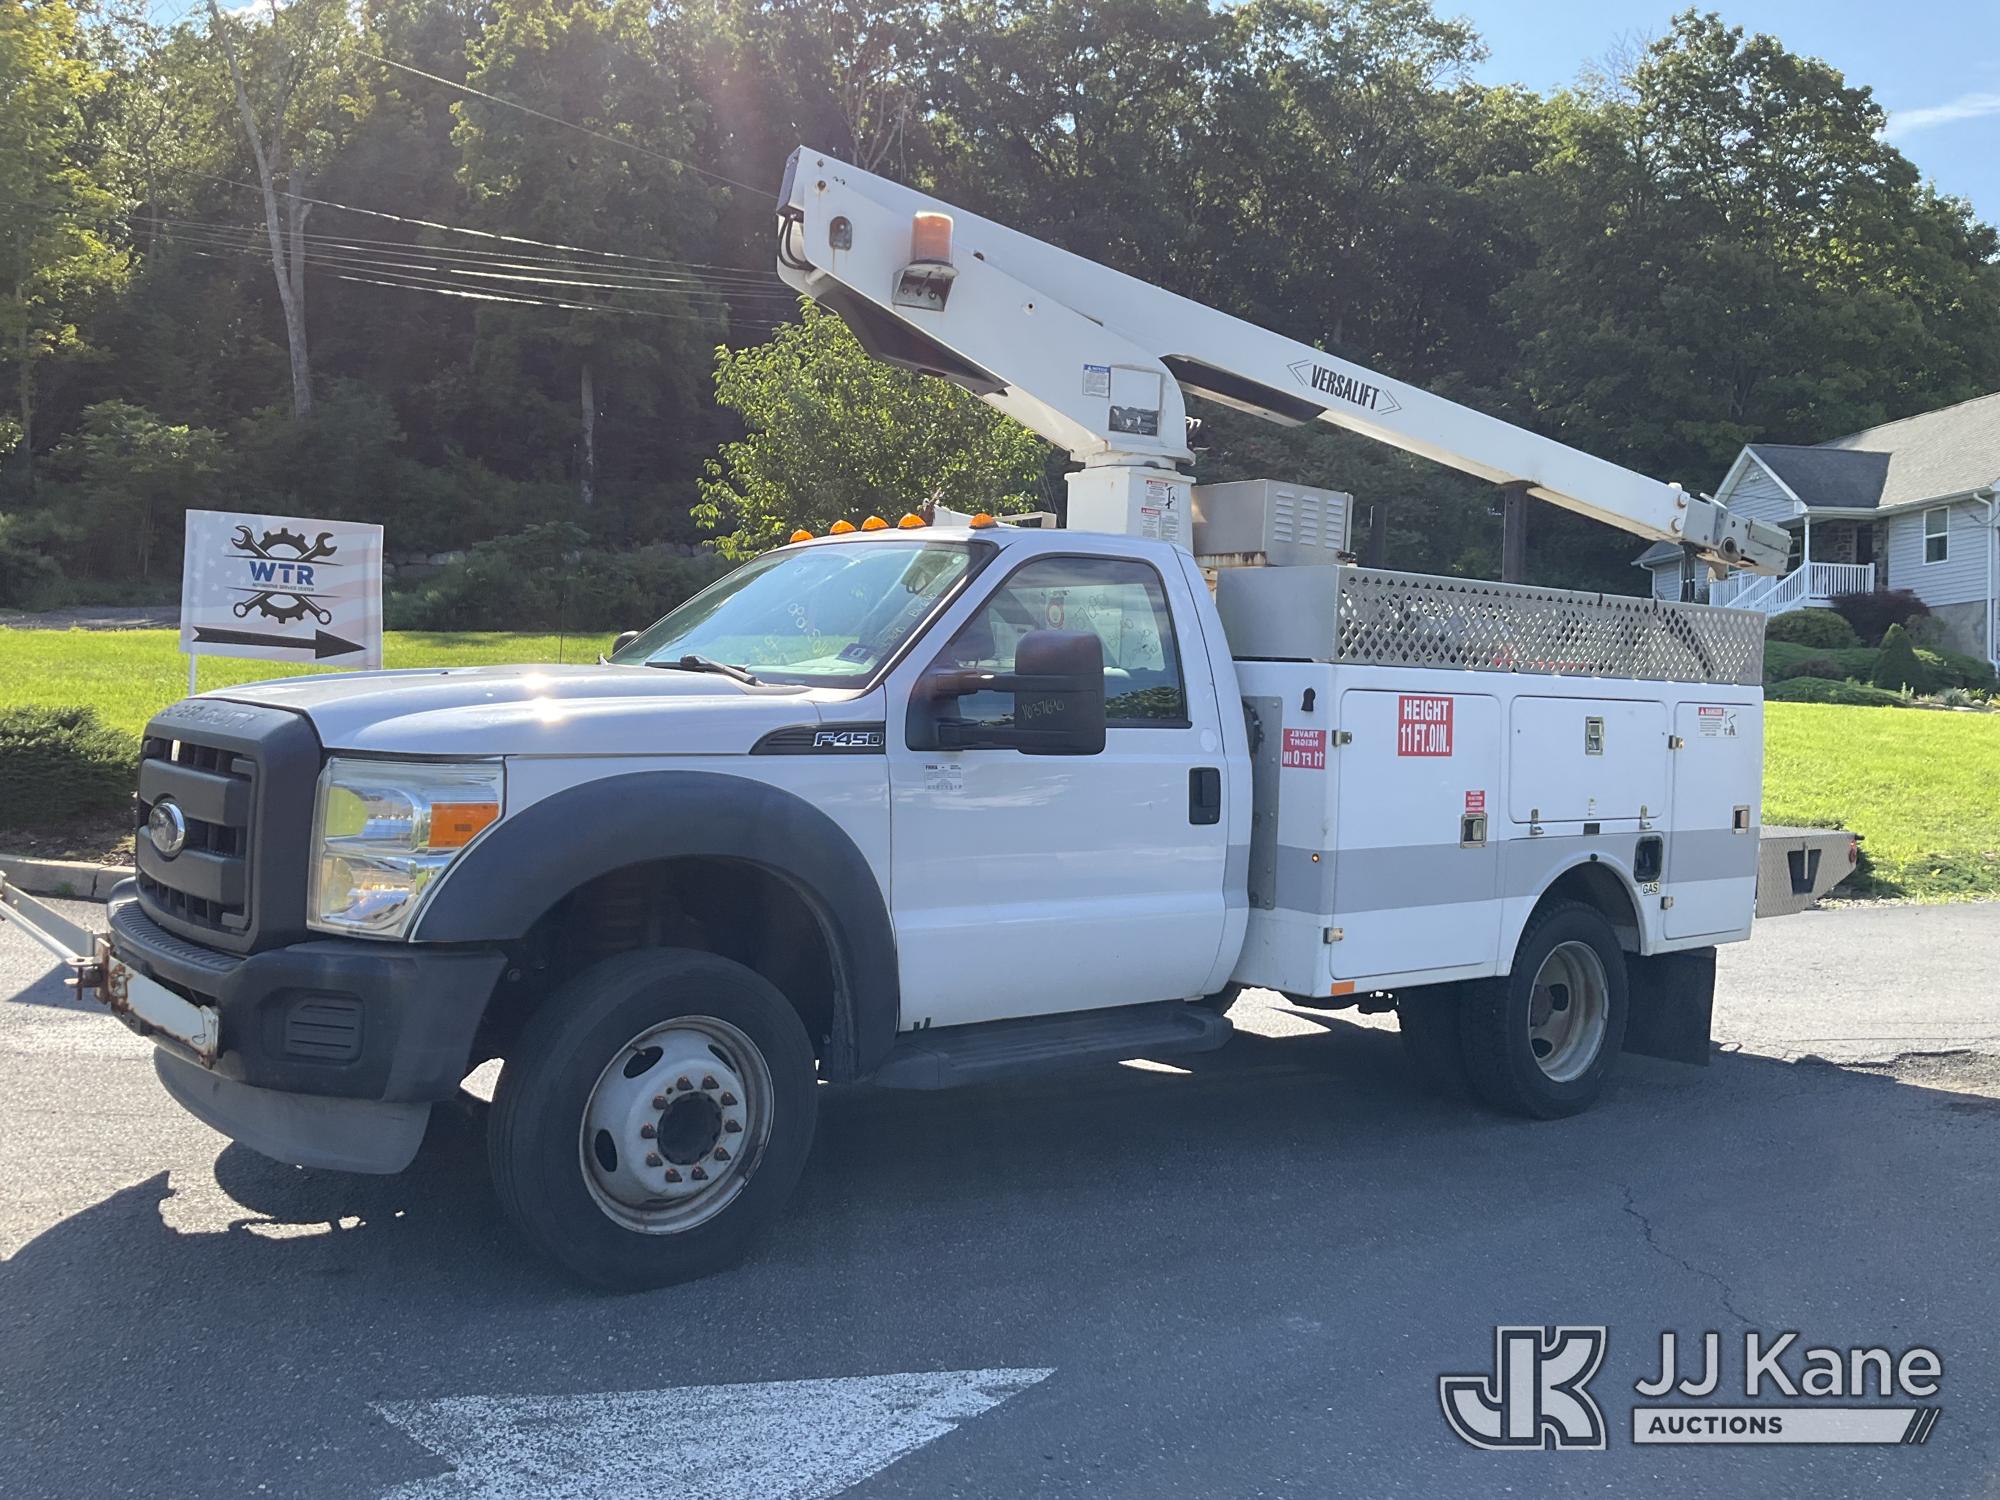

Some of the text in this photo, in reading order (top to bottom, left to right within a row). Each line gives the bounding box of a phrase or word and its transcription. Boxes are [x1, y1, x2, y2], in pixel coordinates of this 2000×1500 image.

[1311, 364, 1380, 410] VERSALIFT
[249, 561, 315, 586] WTR
[1404, 699, 1449, 721] HEIGHT
[813, 731, 884, 747] F-450
[1642, 882, 1658, 895] GAS
